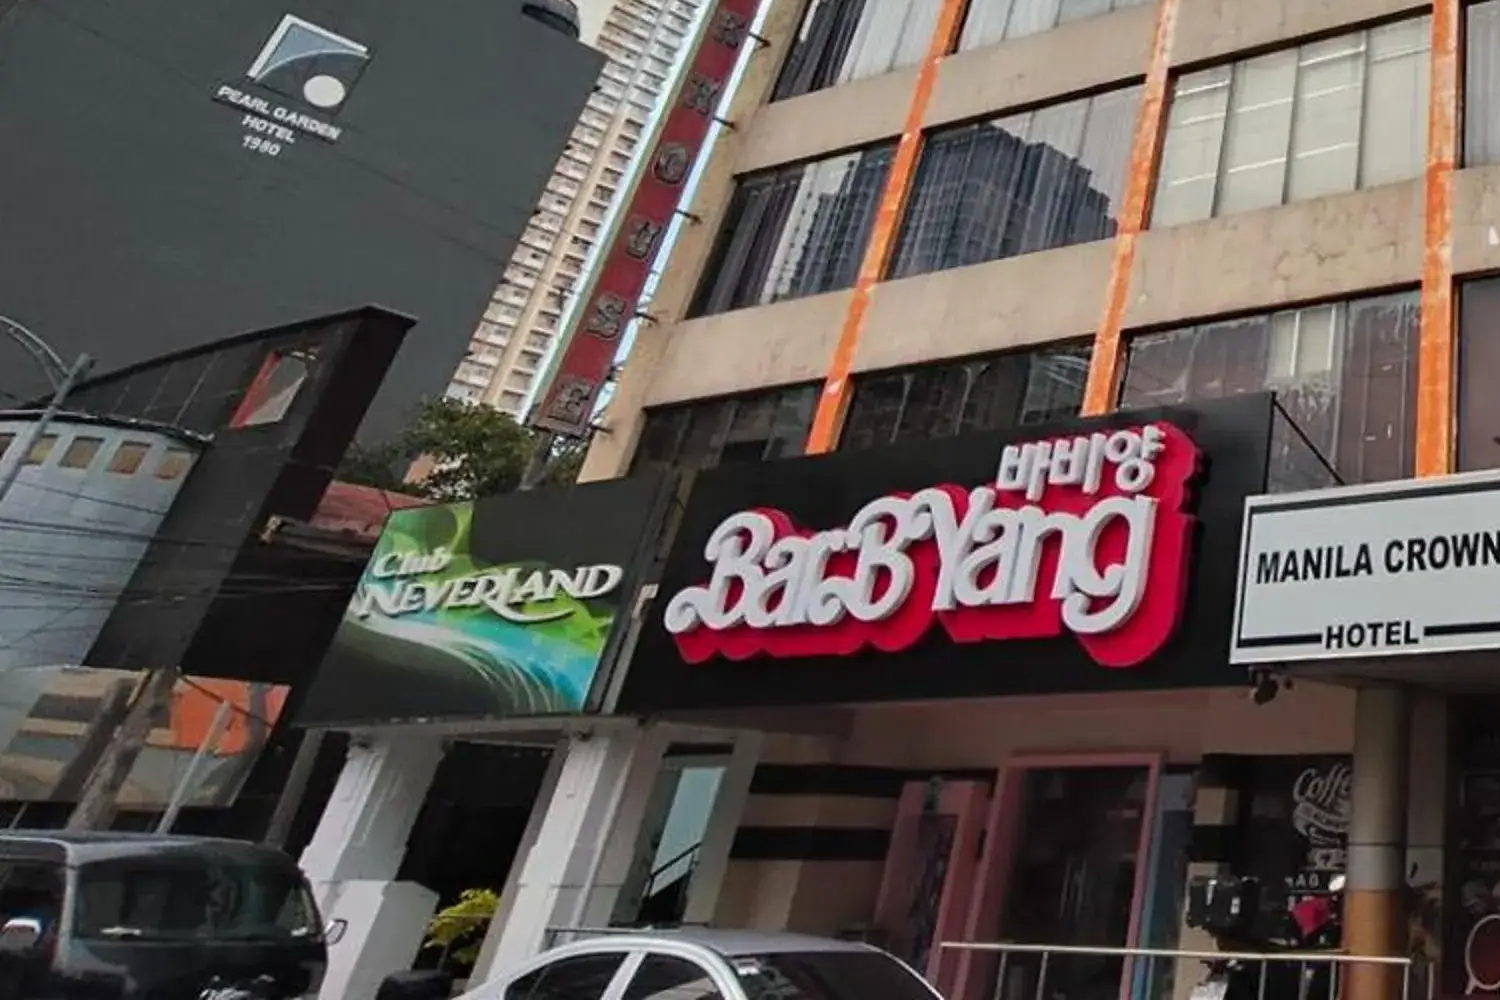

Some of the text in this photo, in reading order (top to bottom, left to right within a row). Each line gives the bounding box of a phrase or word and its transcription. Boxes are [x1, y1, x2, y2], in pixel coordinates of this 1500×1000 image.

[217, 85, 342, 140] PEARL GARDEN
[242, 114, 296, 144] HOTEL
[997, 424, 1168, 500] 바비양
[373, 547, 449, 579] Club
[1256, 543, 1373, 584] MANILA
[355, 564, 623, 621] NEVERLAND
[1325, 620, 1420, 649] HOTEL
[1293, 763, 1353, 807] Coffe
